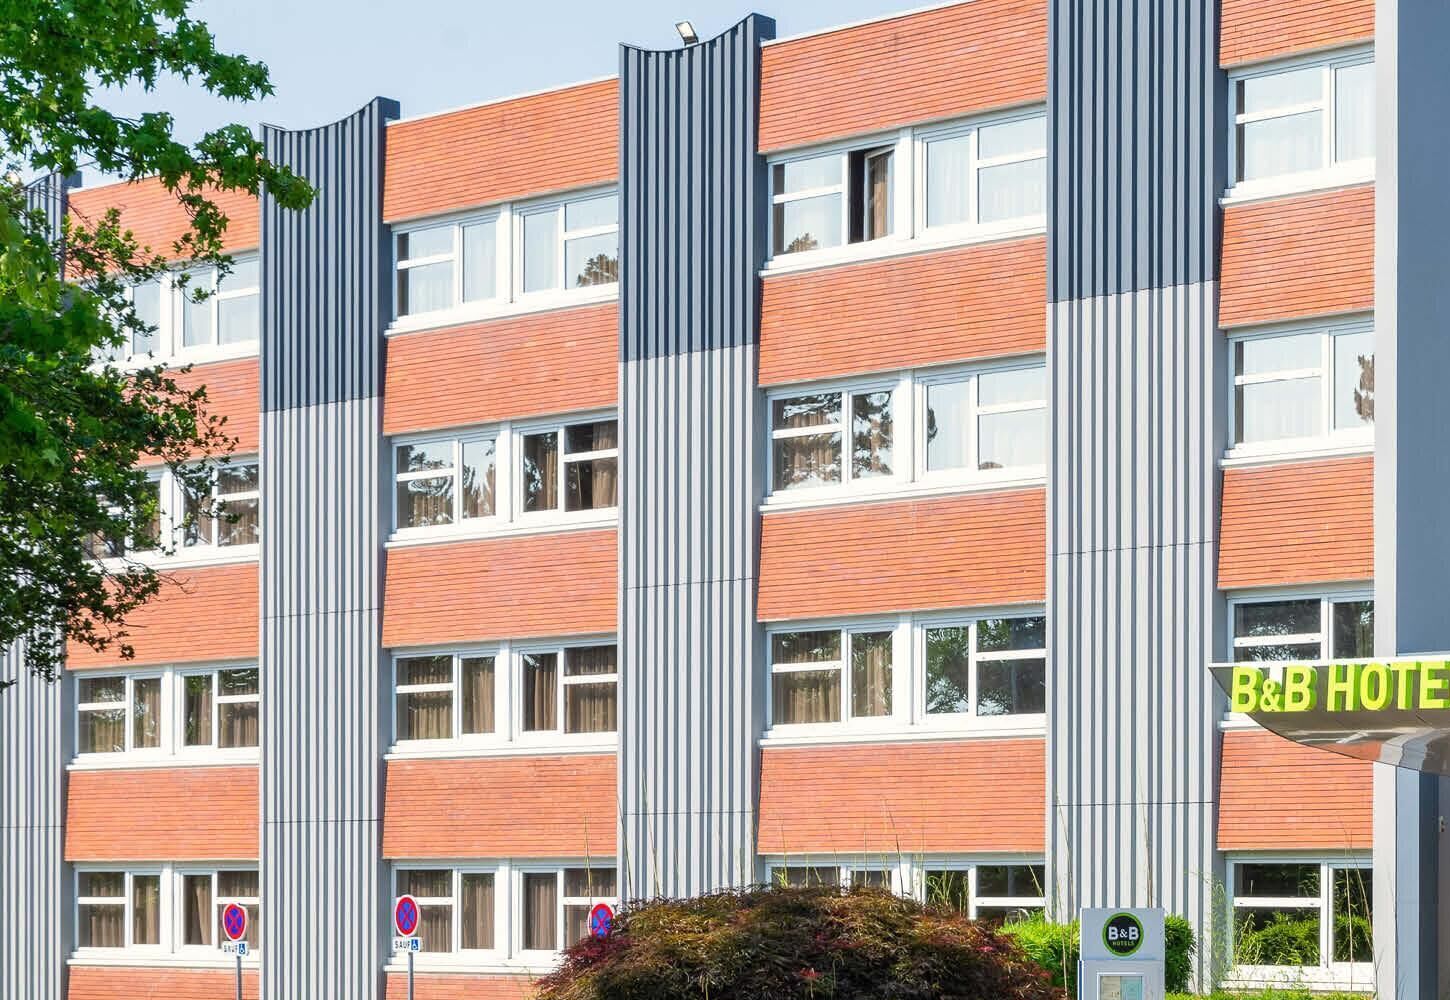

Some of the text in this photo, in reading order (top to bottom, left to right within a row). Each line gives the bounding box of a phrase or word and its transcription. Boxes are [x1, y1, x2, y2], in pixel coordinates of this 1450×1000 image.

[1231, 664, 1318, 713] B&B
[1108, 926, 1139, 940] B&B
[395, 940, 410, 949] SAUF
